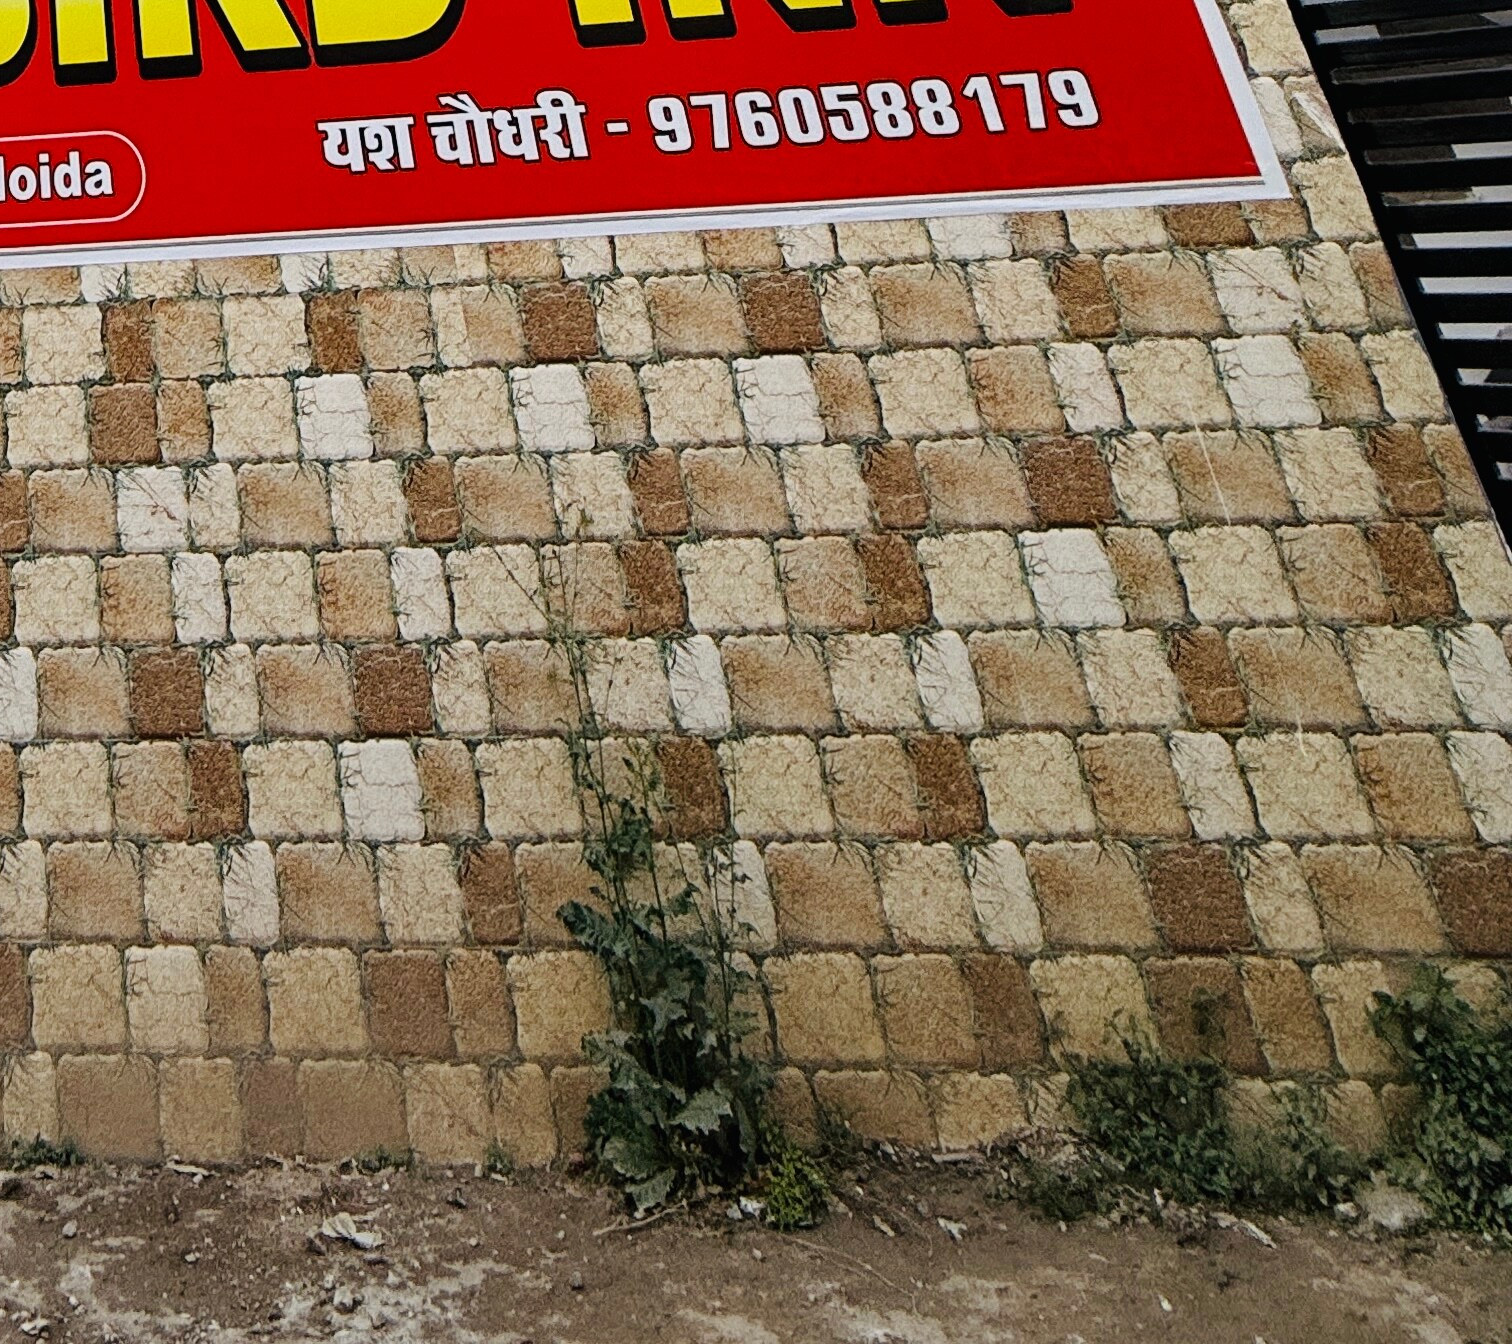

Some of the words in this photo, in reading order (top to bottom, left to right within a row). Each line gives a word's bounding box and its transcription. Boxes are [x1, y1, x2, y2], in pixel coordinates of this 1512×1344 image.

[316, 115, 416, 173] यश
[425, 87, 590, 166] चौधरी
[648, 69, 1100, 154] 9760588179
